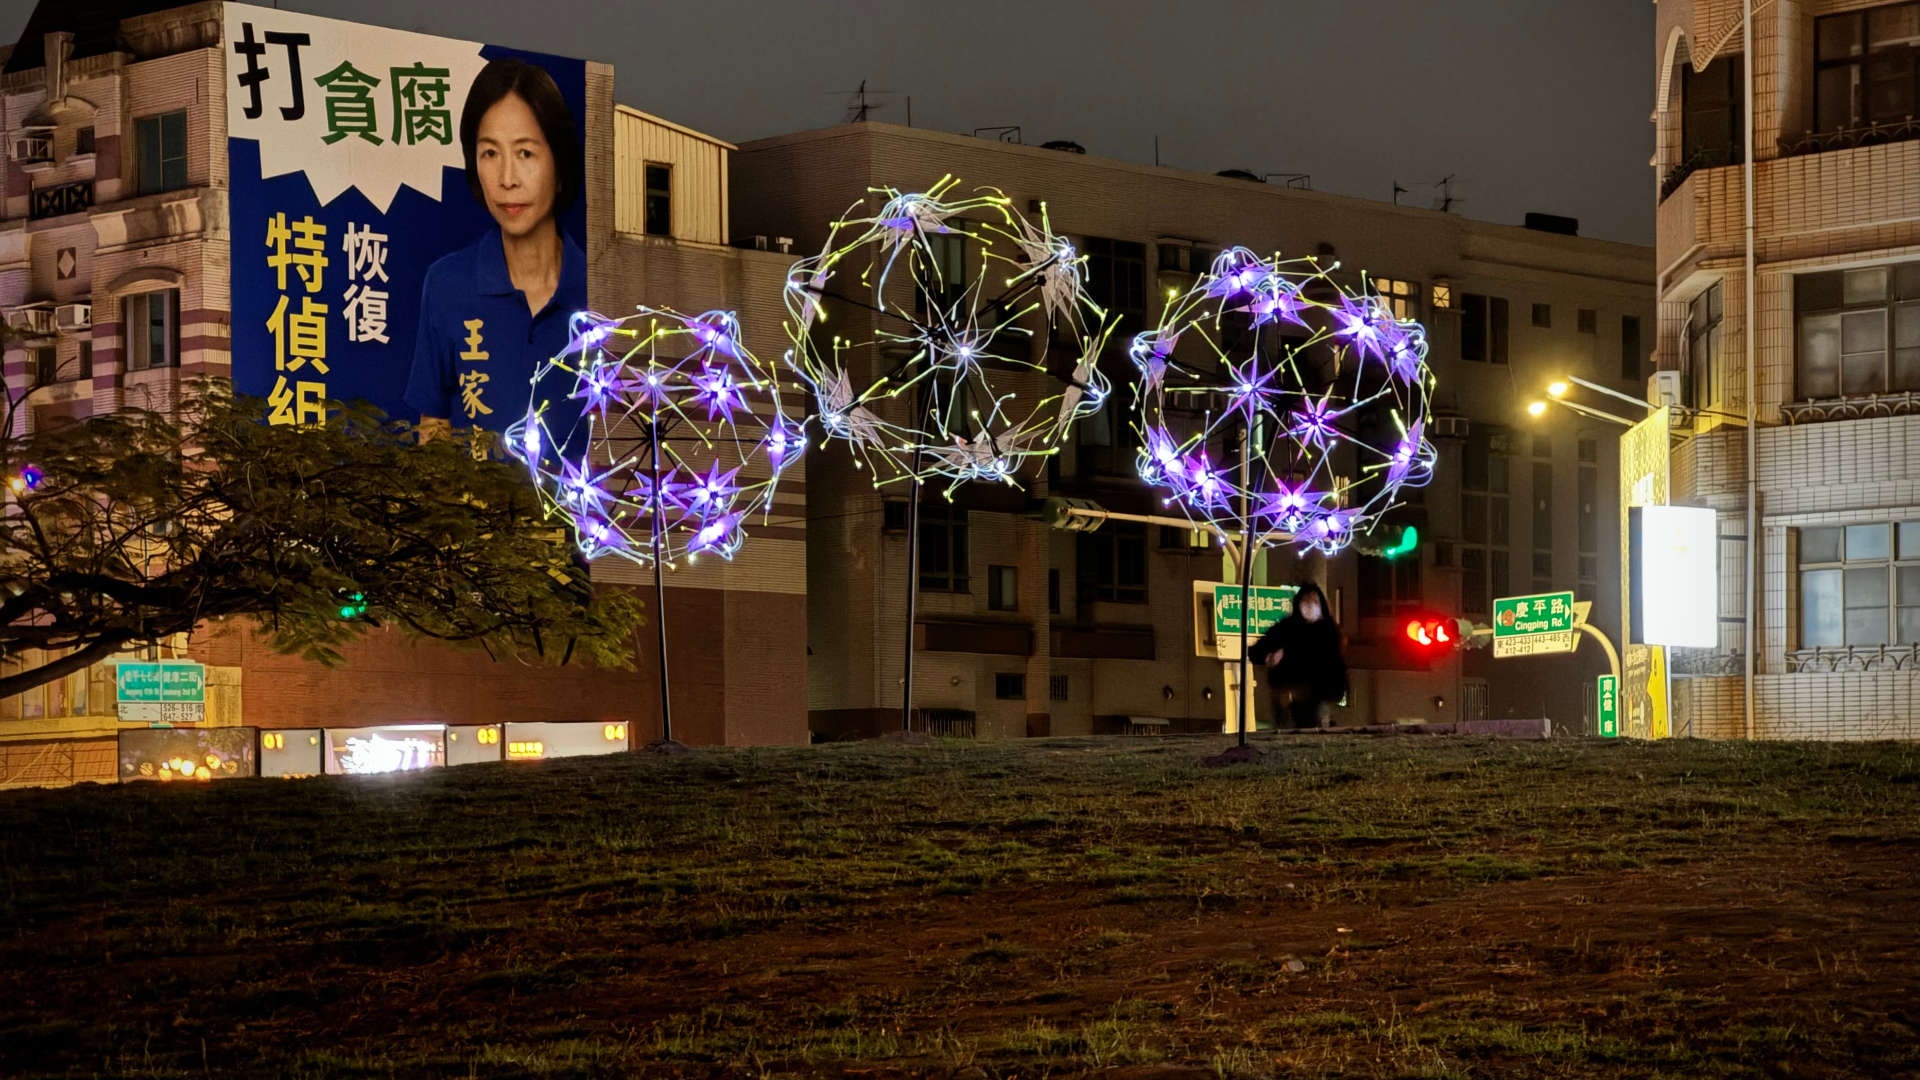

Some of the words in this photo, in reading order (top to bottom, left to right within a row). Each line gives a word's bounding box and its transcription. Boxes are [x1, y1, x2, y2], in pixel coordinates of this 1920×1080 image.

[234, 22, 453, 147] 打貪腐
[342, 222, 391, 344] 恢復
[265, 212, 330, 432] 特偵組
[1516, 598, 1564, 617] 慶平路
[1515, 621, 1548, 632] Cingping
[1552, 618, 1564, 627] Rd.
[263, 732, 284, 750] 01
[604, 724, 626, 741] 04
